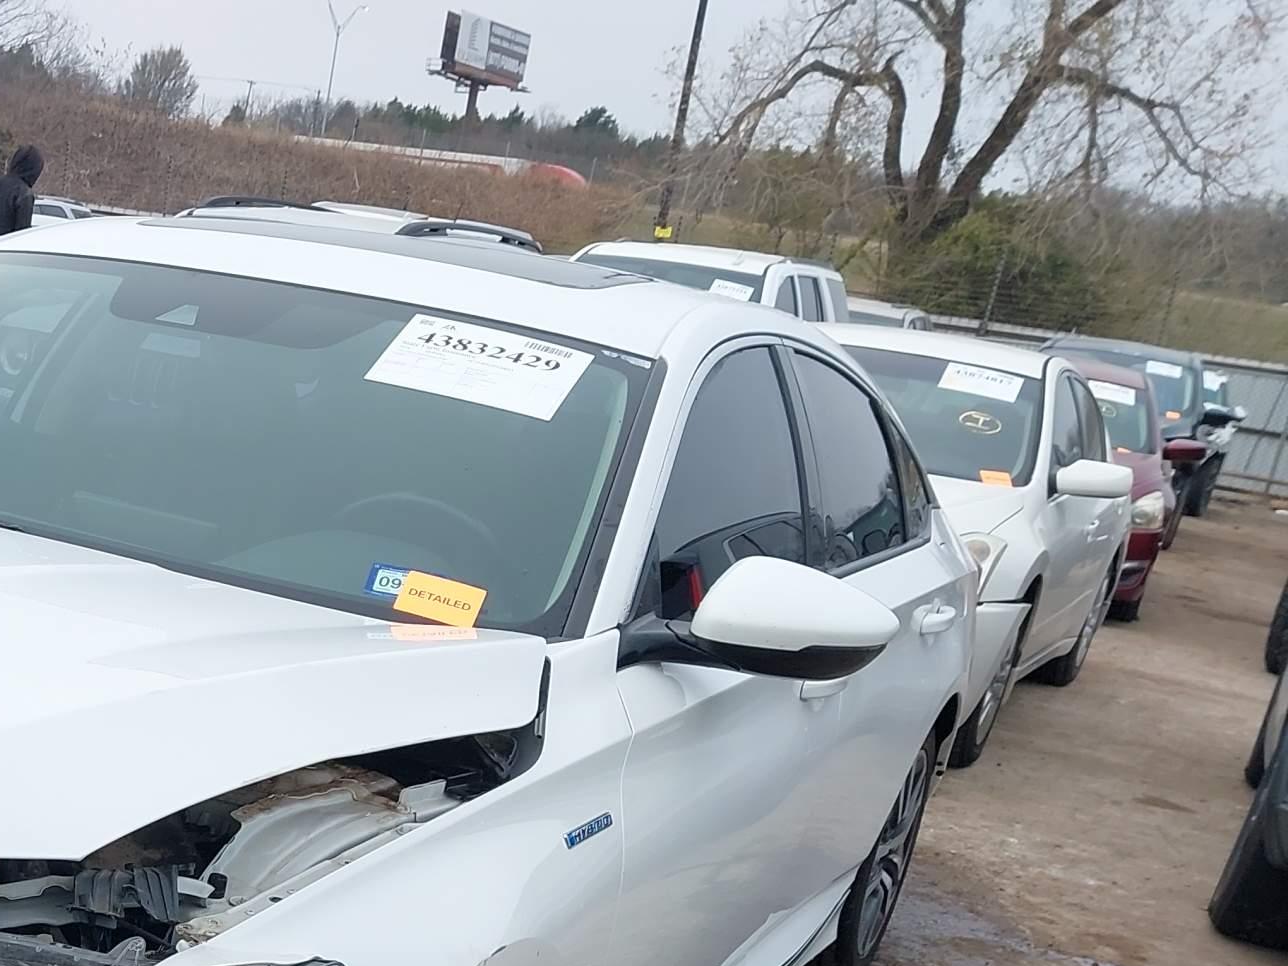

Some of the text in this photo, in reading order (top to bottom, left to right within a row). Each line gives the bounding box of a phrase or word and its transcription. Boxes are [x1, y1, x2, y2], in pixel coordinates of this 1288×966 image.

[416, 331, 562, 372] 43832429
[378, 575, 402, 590] 09
[408, 587, 472, 611] DETAILED
